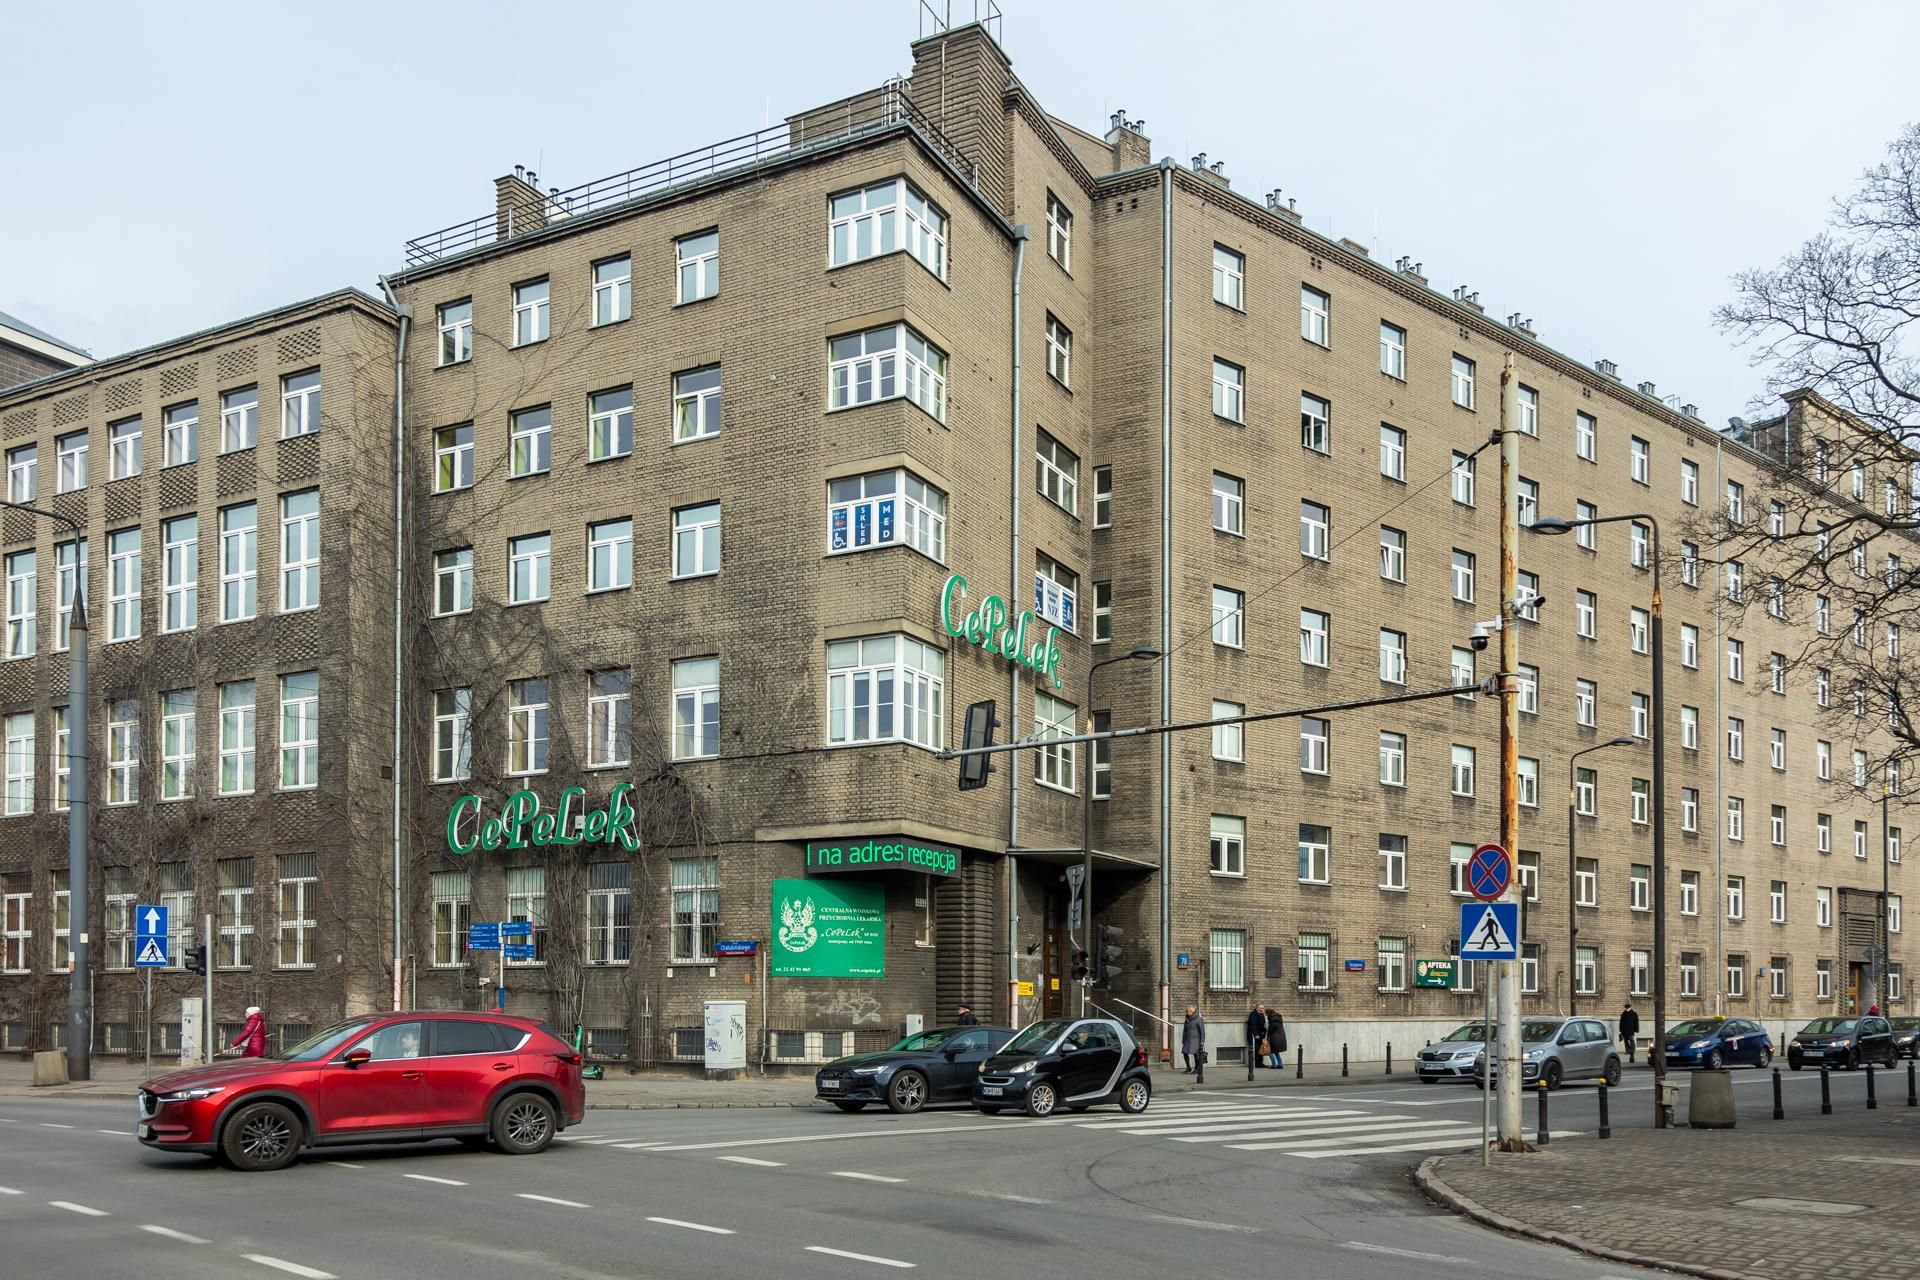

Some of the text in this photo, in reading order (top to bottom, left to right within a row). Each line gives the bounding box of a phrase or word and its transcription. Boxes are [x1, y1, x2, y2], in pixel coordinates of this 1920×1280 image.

[882, 504, 891, 538] MED
[941, 575, 1062, 690] CePeLek
[447, 783, 640, 853] CePeLek
[818, 847, 842, 865] na
[849, 840, 904, 864] adres
[907, 846, 956, 874] recepcja
[1180, 957, 1188, 966] 78
[1427, 961, 1452, 969] APTEKA
